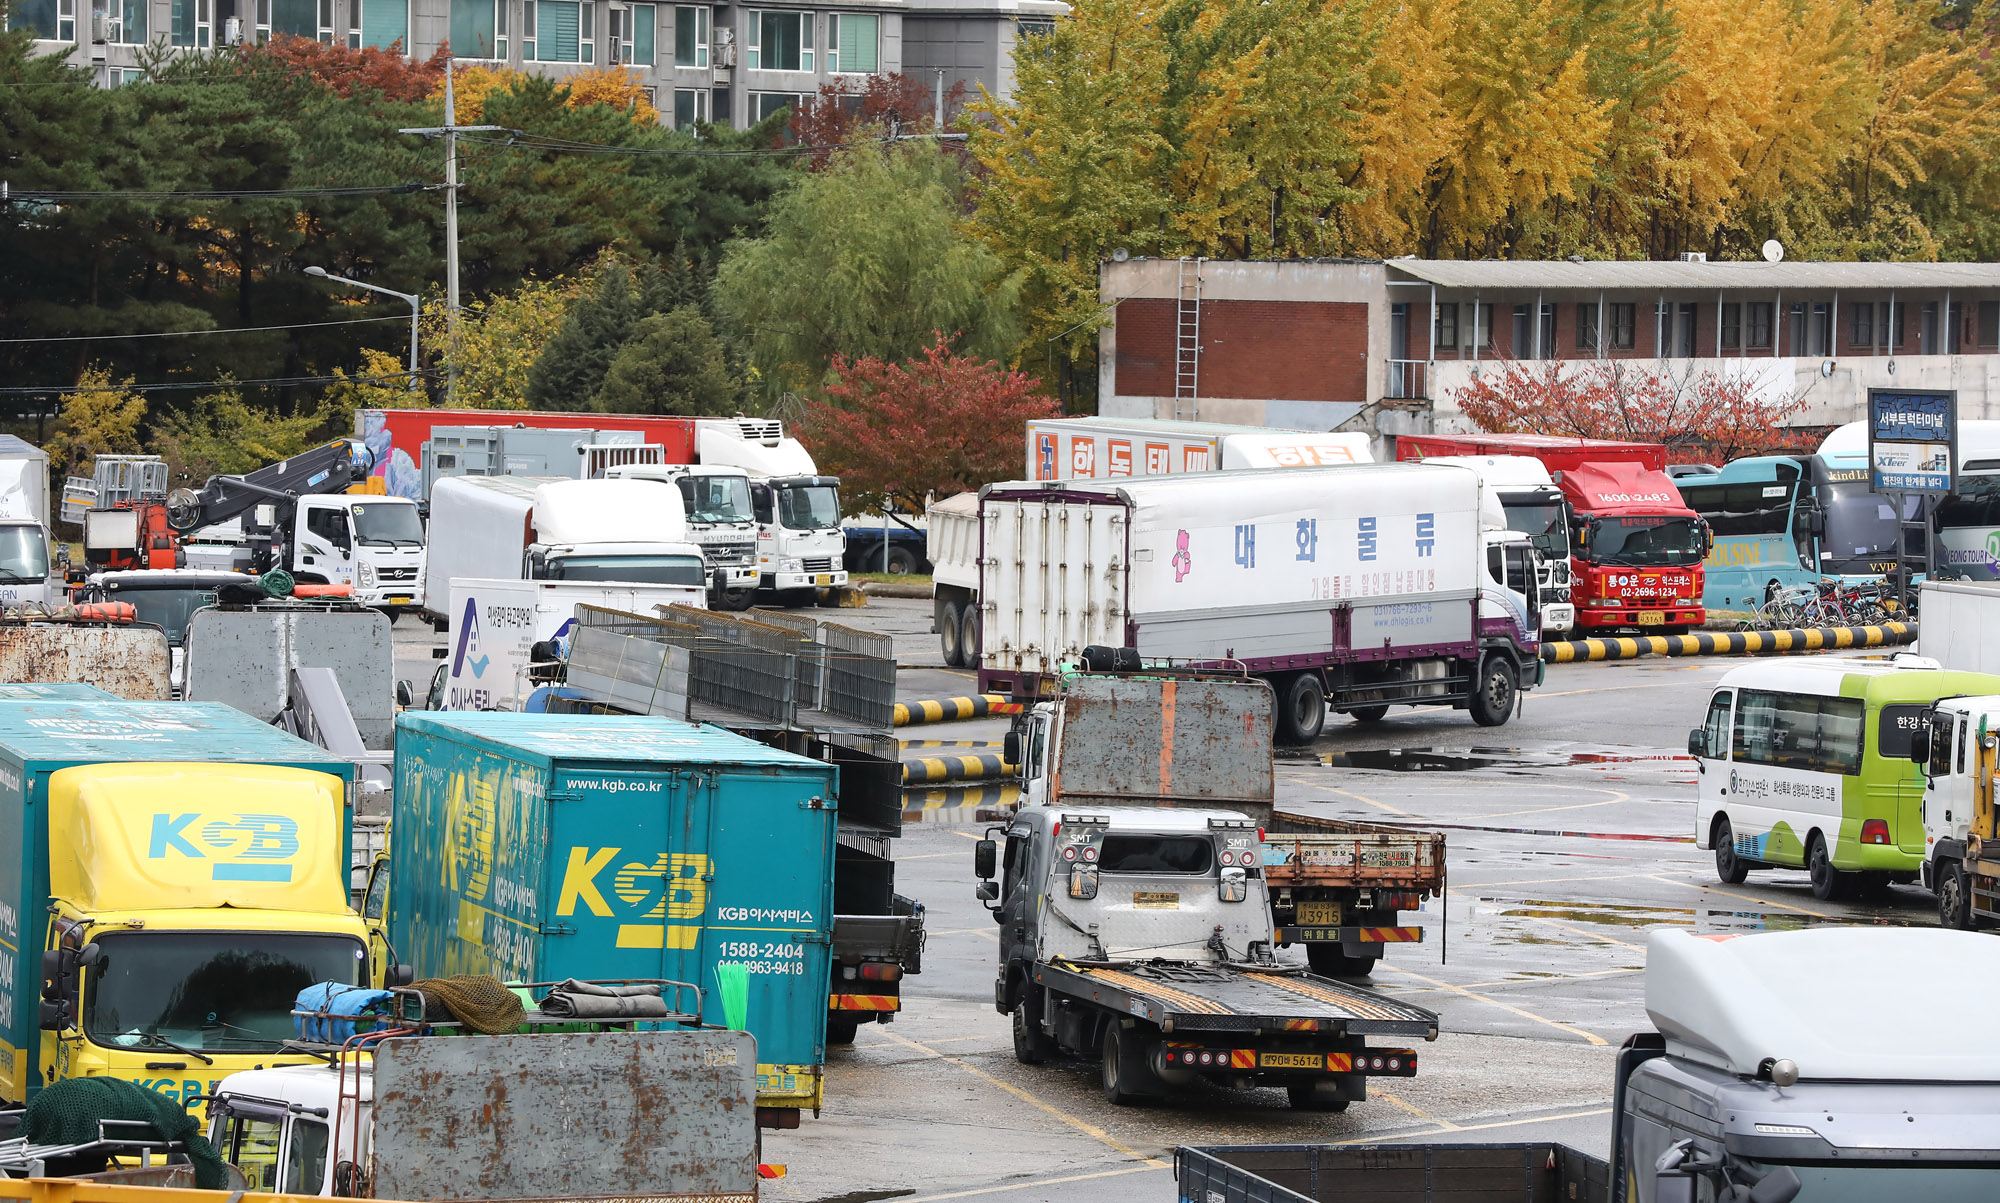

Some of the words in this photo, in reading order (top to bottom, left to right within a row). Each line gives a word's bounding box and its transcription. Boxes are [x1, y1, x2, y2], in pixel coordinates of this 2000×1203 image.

[1880, 412, 1943, 428] 서부트럭터미널
[1877, 456, 1908, 467] XTeer
[1829, 471, 1855, 481] kind
[1882, 476, 1903, 486] 엔진의
[1905, 476, 1926, 487] 한계를
[1928, 477, 1942, 487] 넘다
[703, 534, 746, 542] HYUNDAI
[1234, 512, 1435, 569] 대화물류
[1967, 550, 1984, 563] TOUR
[1661, 576, 1691, 586] 익스프레스
[1621, 587, 1677, 597] 02-2696-1234
[1896, 716, 1932, 729] 한강수
[566, 778, 663, 794] www.kgb.co.kr
[1738, 777, 1769, 799] 한강수병원
[1811, 785, 1825, 801] 전문의
[1826, 787, 1836, 802] 그룹
[148, 812, 300, 859] KGB
[1070, 834, 1092, 843] SMT
[1227, 838, 1249, 847] SMT
[555, 846, 715, 919] KGB
[718, 907, 813, 923] KGB이사서비스
[1304, 930, 1337, 940] 위험물
[719, 941, 804, 959] 1588-2404
[1292, 1055, 1319, 1067] 5614
